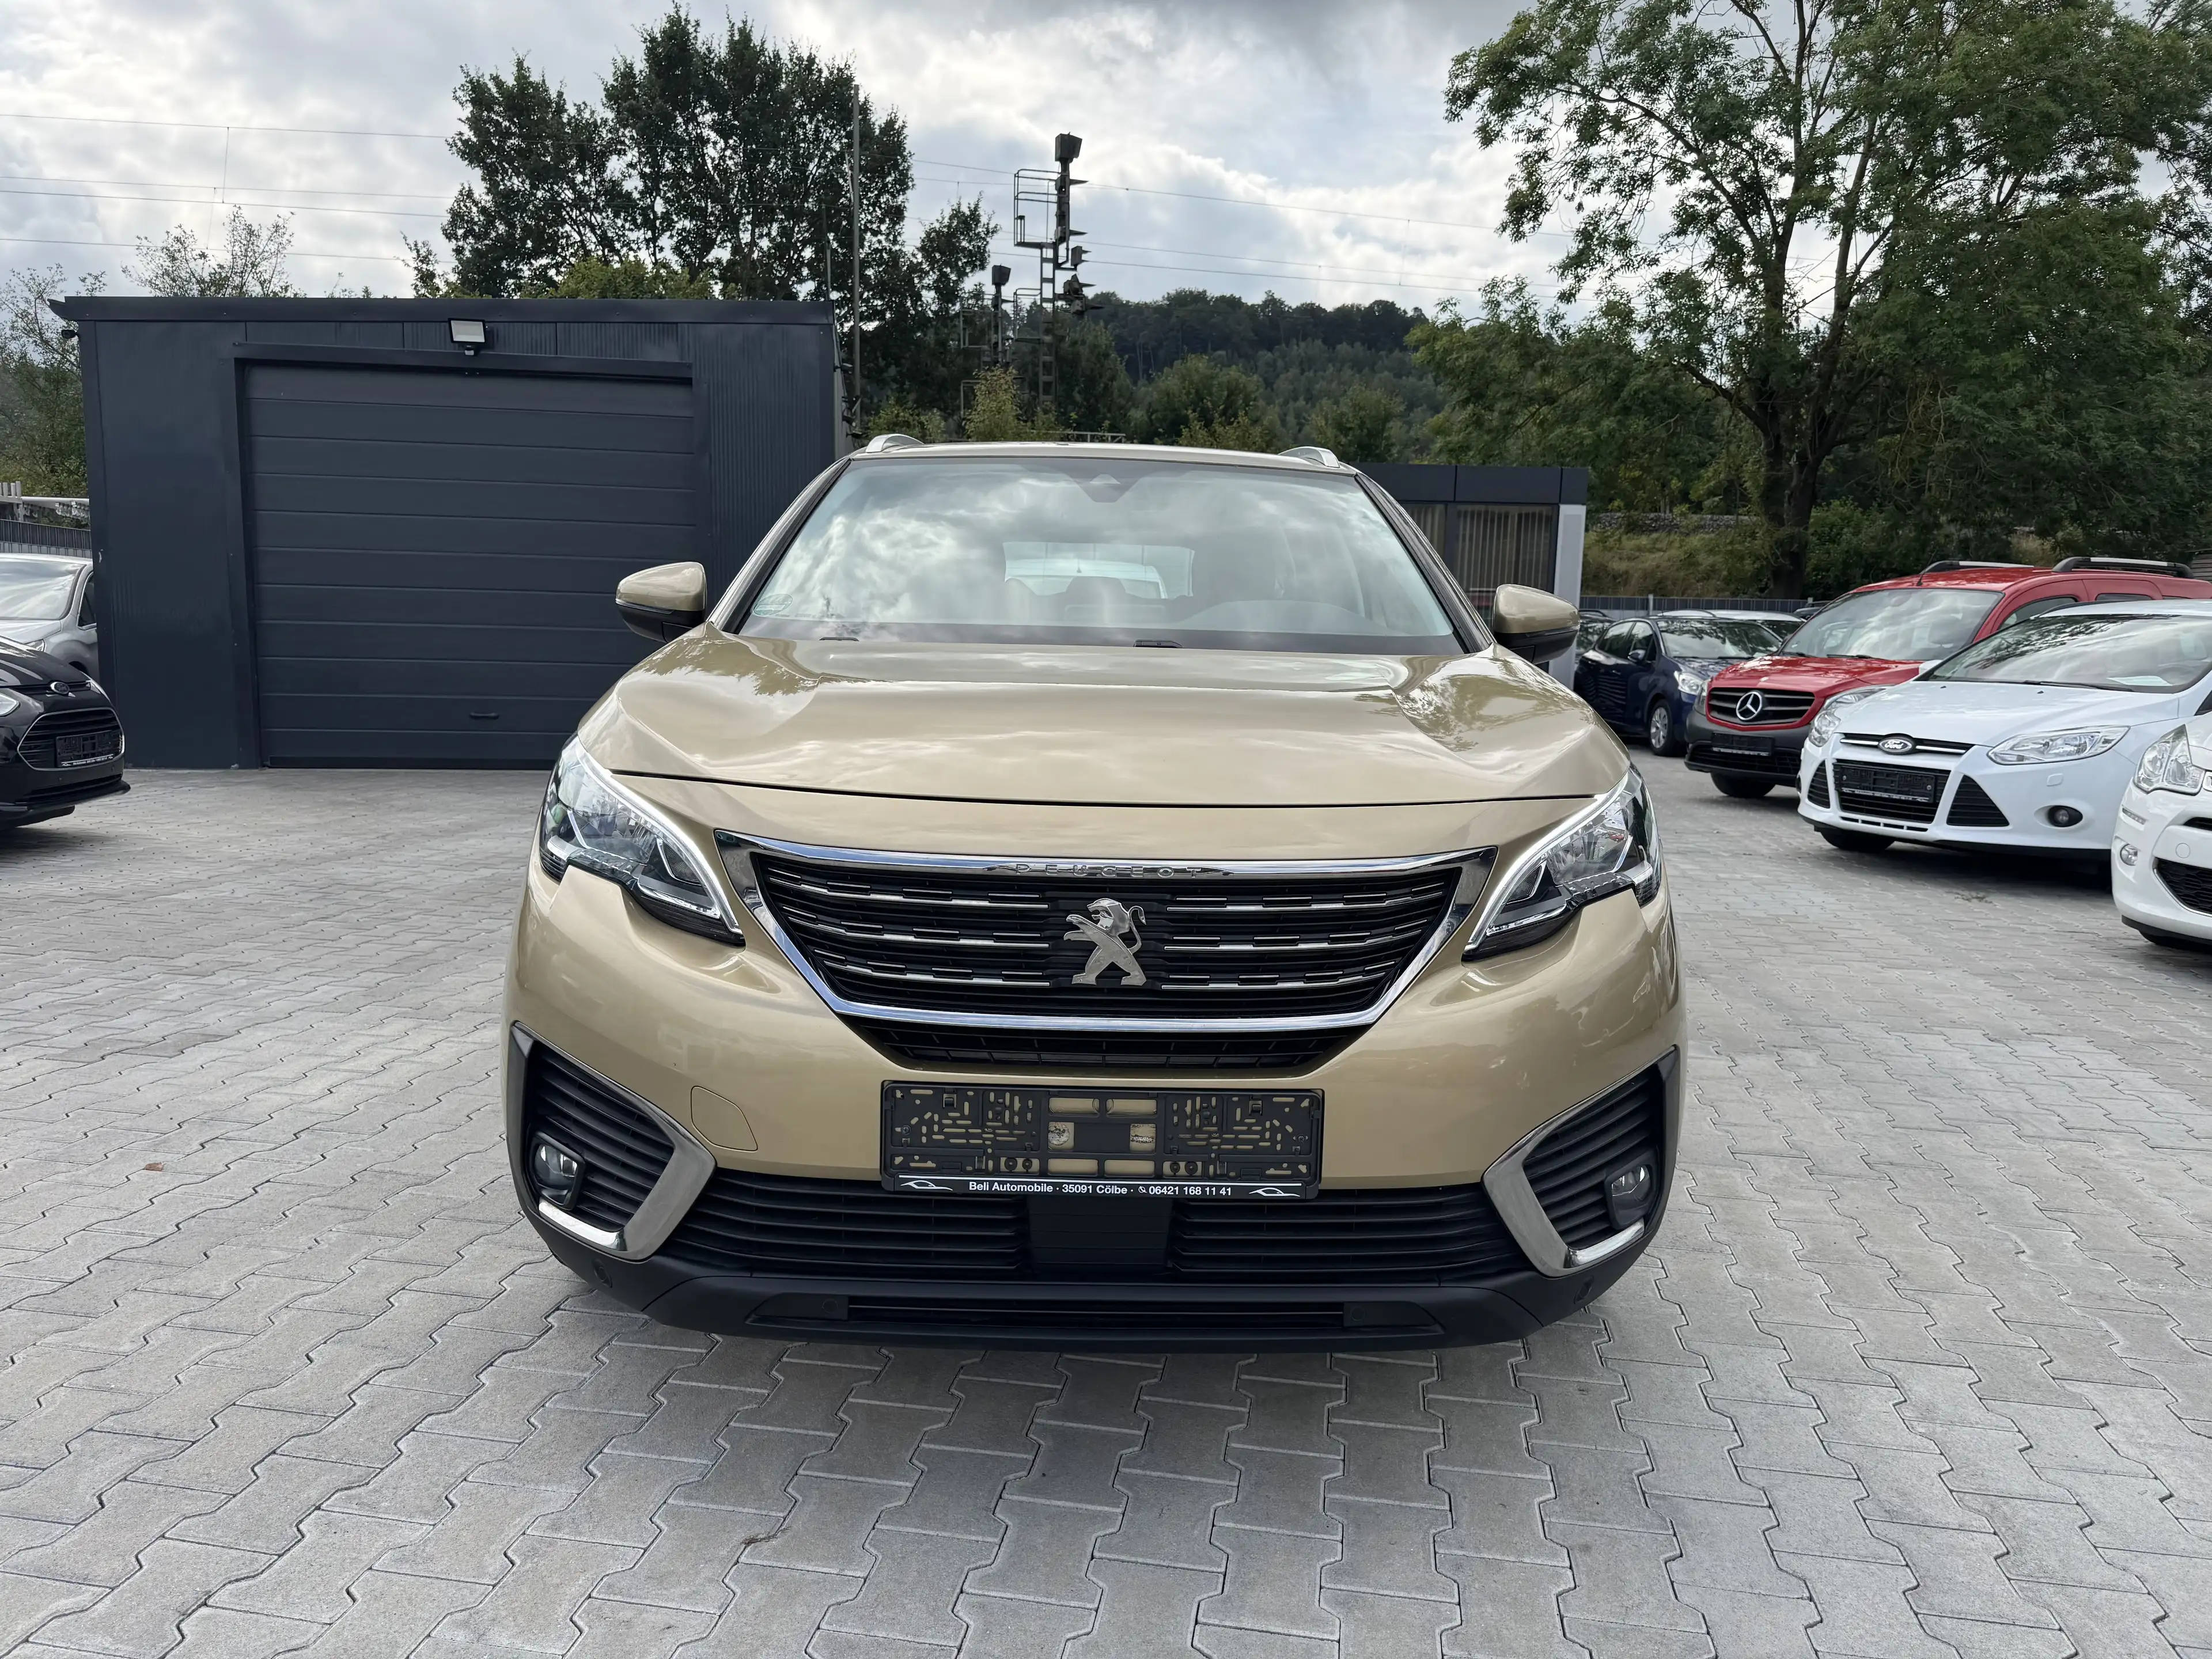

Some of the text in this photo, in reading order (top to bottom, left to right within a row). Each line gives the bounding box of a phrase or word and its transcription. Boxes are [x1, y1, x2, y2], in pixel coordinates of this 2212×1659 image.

[1884, 740, 1904, 749] Ford
[1016, 863, 1202, 878] PEUGEOT
[969, 1181, 1231, 1196] Beli Automobile 35091 Cölbe 06421 168 11 41
